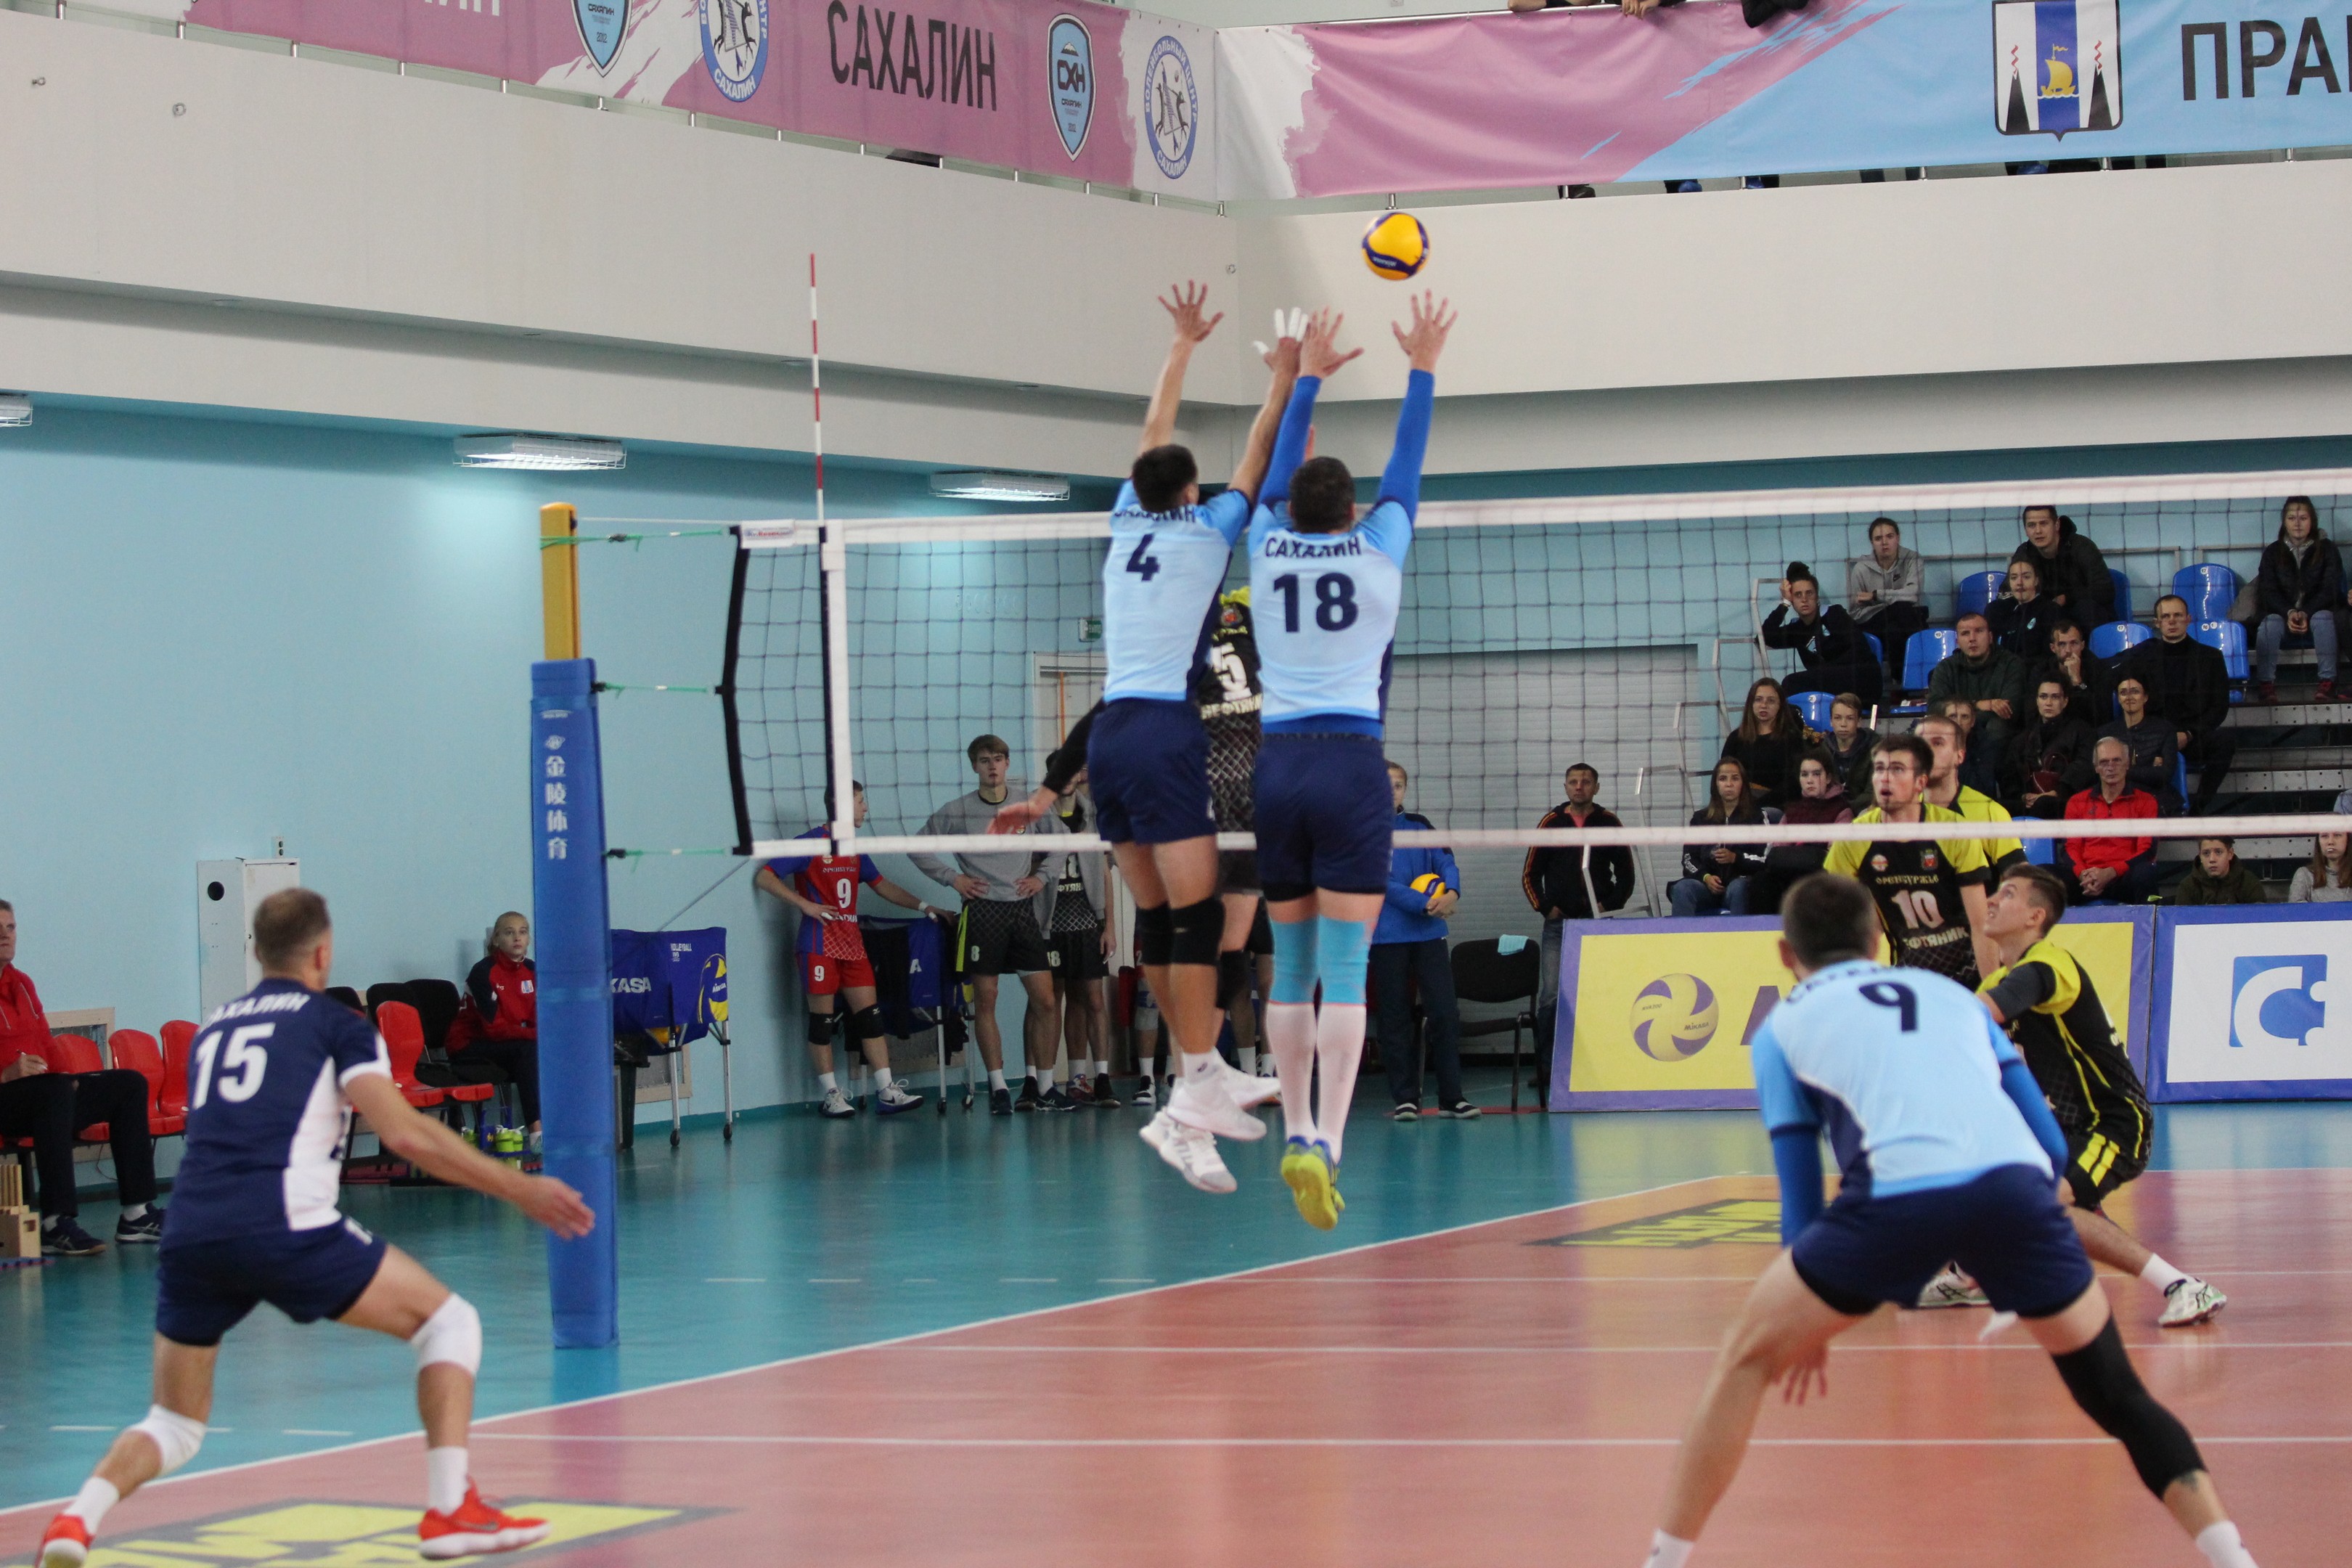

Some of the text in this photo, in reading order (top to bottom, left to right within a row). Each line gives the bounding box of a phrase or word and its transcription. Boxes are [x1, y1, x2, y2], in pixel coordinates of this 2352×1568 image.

[827, 0, 997, 111] САХАЛИН
[2181, 15, 2352, 100] ПРА
[714, 68, 756, 99] САХАЛИН
[1185, 64, 1197, 122] ЦЕНТР
[1157, 150, 1187, 176] САХАЛИН
[1126, 533, 1160, 581] 4
[1265, 536, 1362, 558] САХАЛИН
[1273, 572, 1359, 632] 18
[545, 756, 568, 860] 金陵体育
[837, 878, 852, 908] 9
[1891, 889, 1945, 929] 10
[971, 945, 980, 962] 8
[1902, 926, 1969, 950] ФТЯНИК
[610, 976, 652, 993] KASA
[814, 965, 825, 981] 9
[1858, 982, 1917, 1032] 9
[192, 1022, 277, 1111] 15
